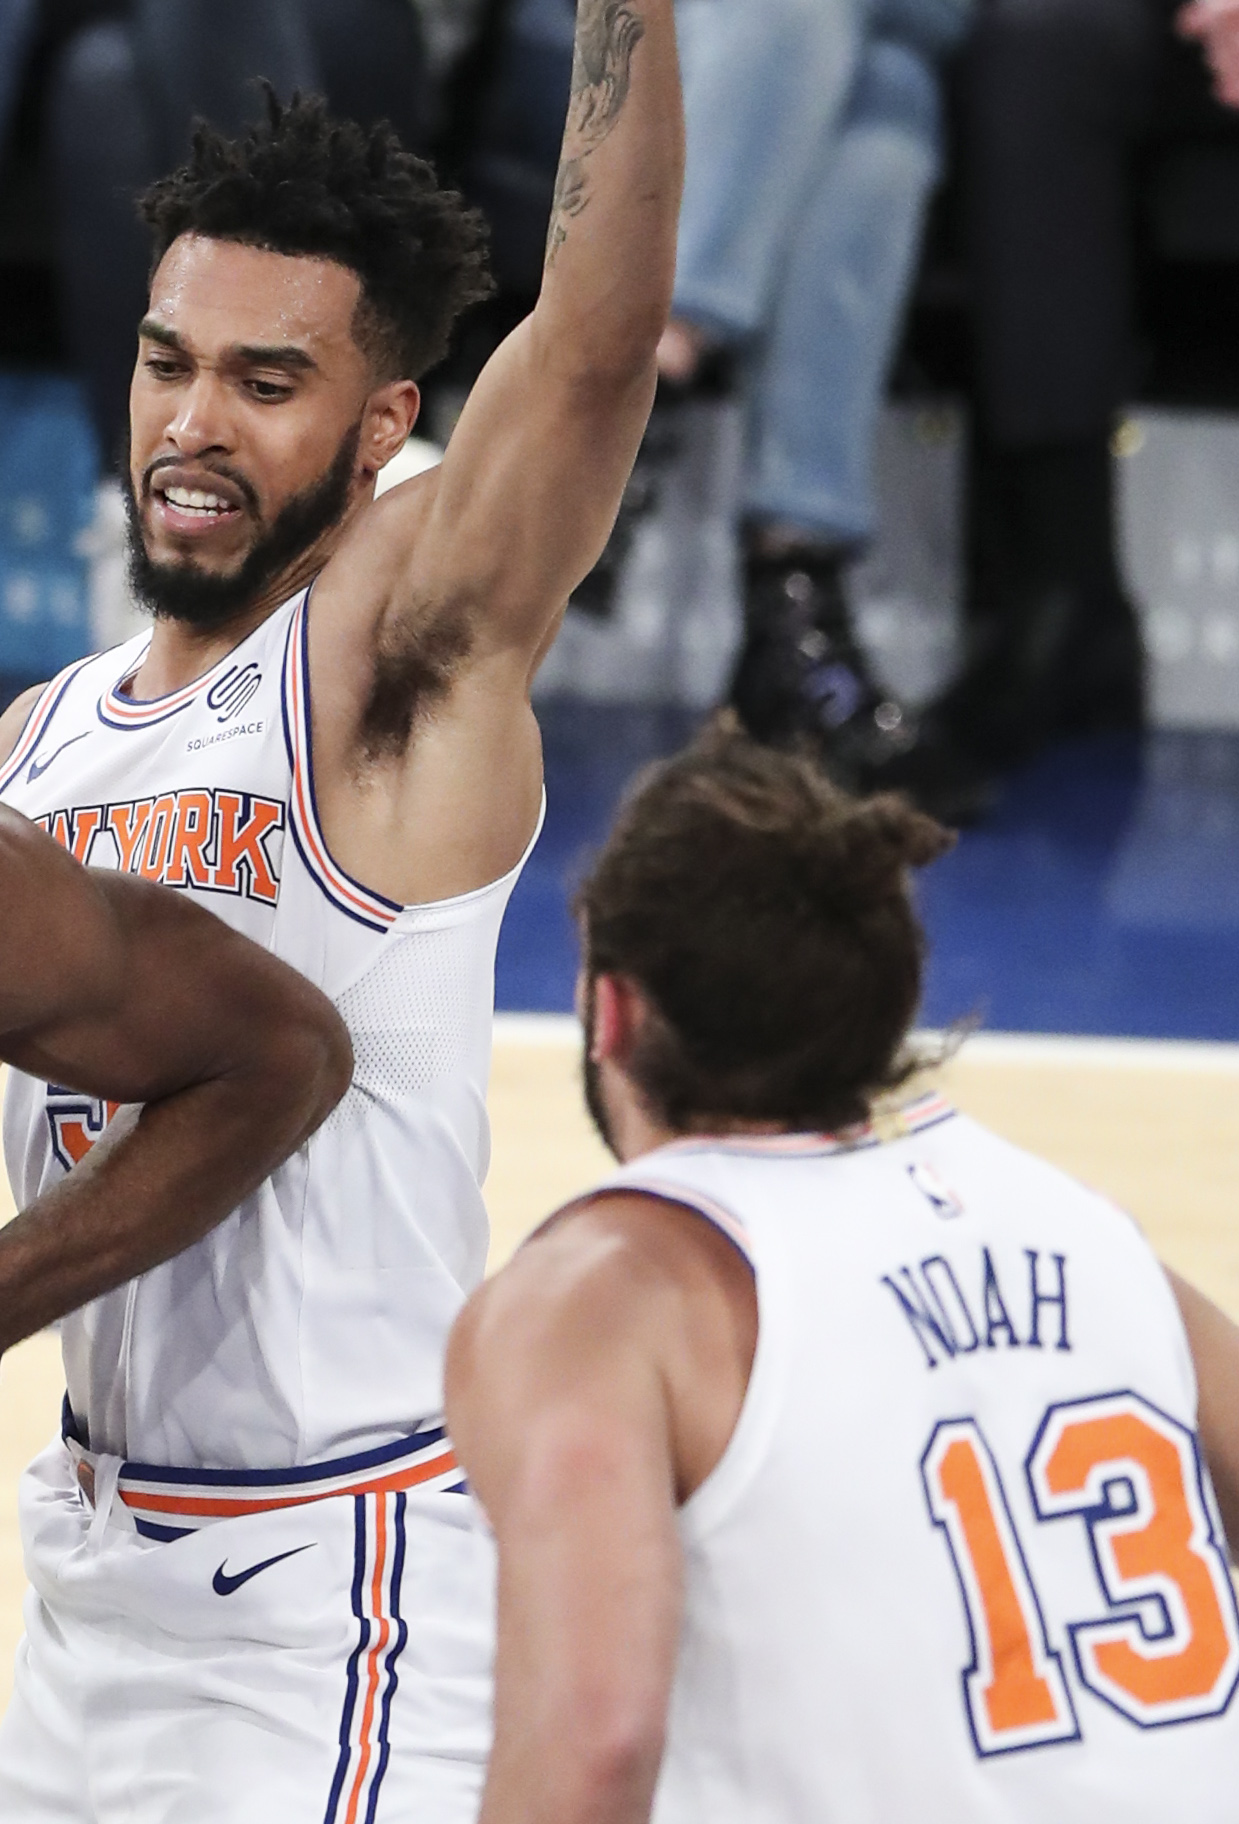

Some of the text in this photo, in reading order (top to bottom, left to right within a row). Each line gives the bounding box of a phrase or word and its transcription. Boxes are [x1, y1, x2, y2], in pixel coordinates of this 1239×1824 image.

[186, 721, 264, 752] SQUARESPACE
[104, 788, 286, 909] YORK
[880, 1246, 1073, 1370] NOAH
[919, 1388, 1239, 1761] 13
